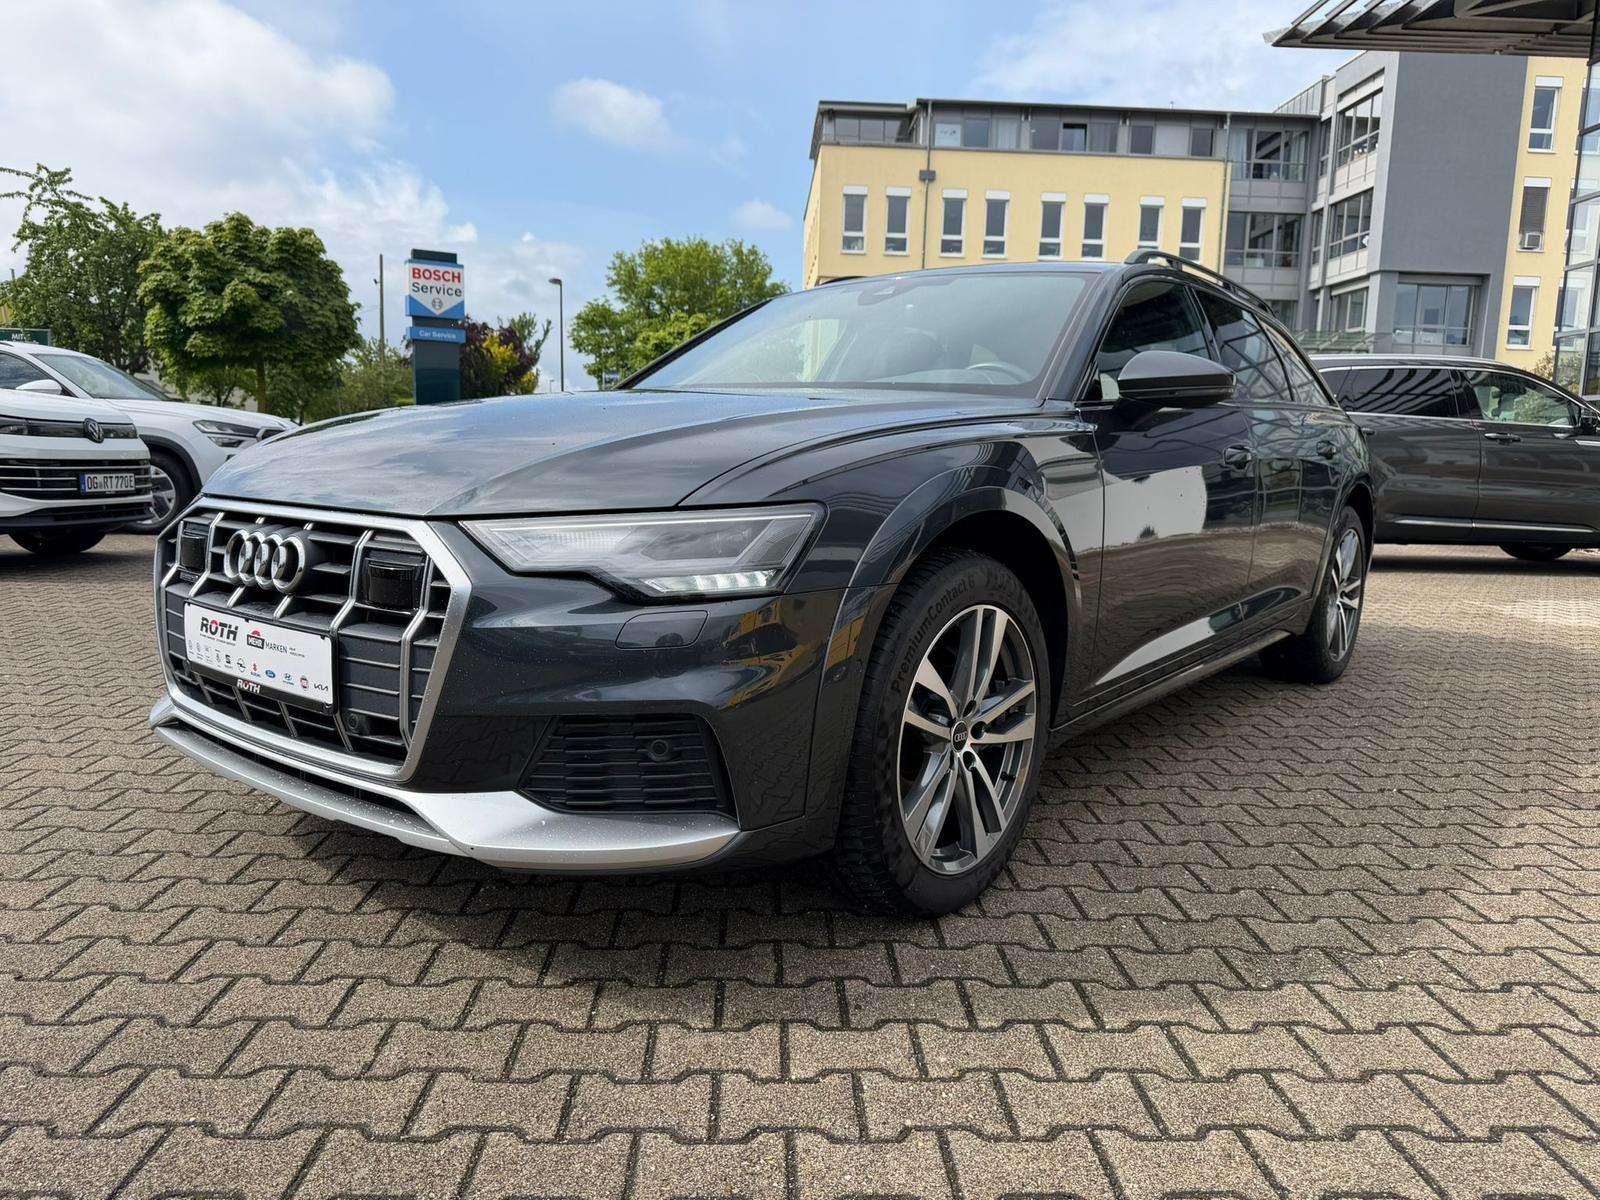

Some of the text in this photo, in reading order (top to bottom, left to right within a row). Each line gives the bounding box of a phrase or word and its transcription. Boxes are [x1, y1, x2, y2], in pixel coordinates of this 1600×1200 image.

[412, 267, 461, 283] BOSCH
[412, 282, 462, 297] Service
[432, 331, 457, 339] Service
[87, 475, 98, 489] OG
[200, 616, 239, 641] ROTH
[265, 641, 288, 654] MARKEN
[237, 679, 261, 694] ROTH
